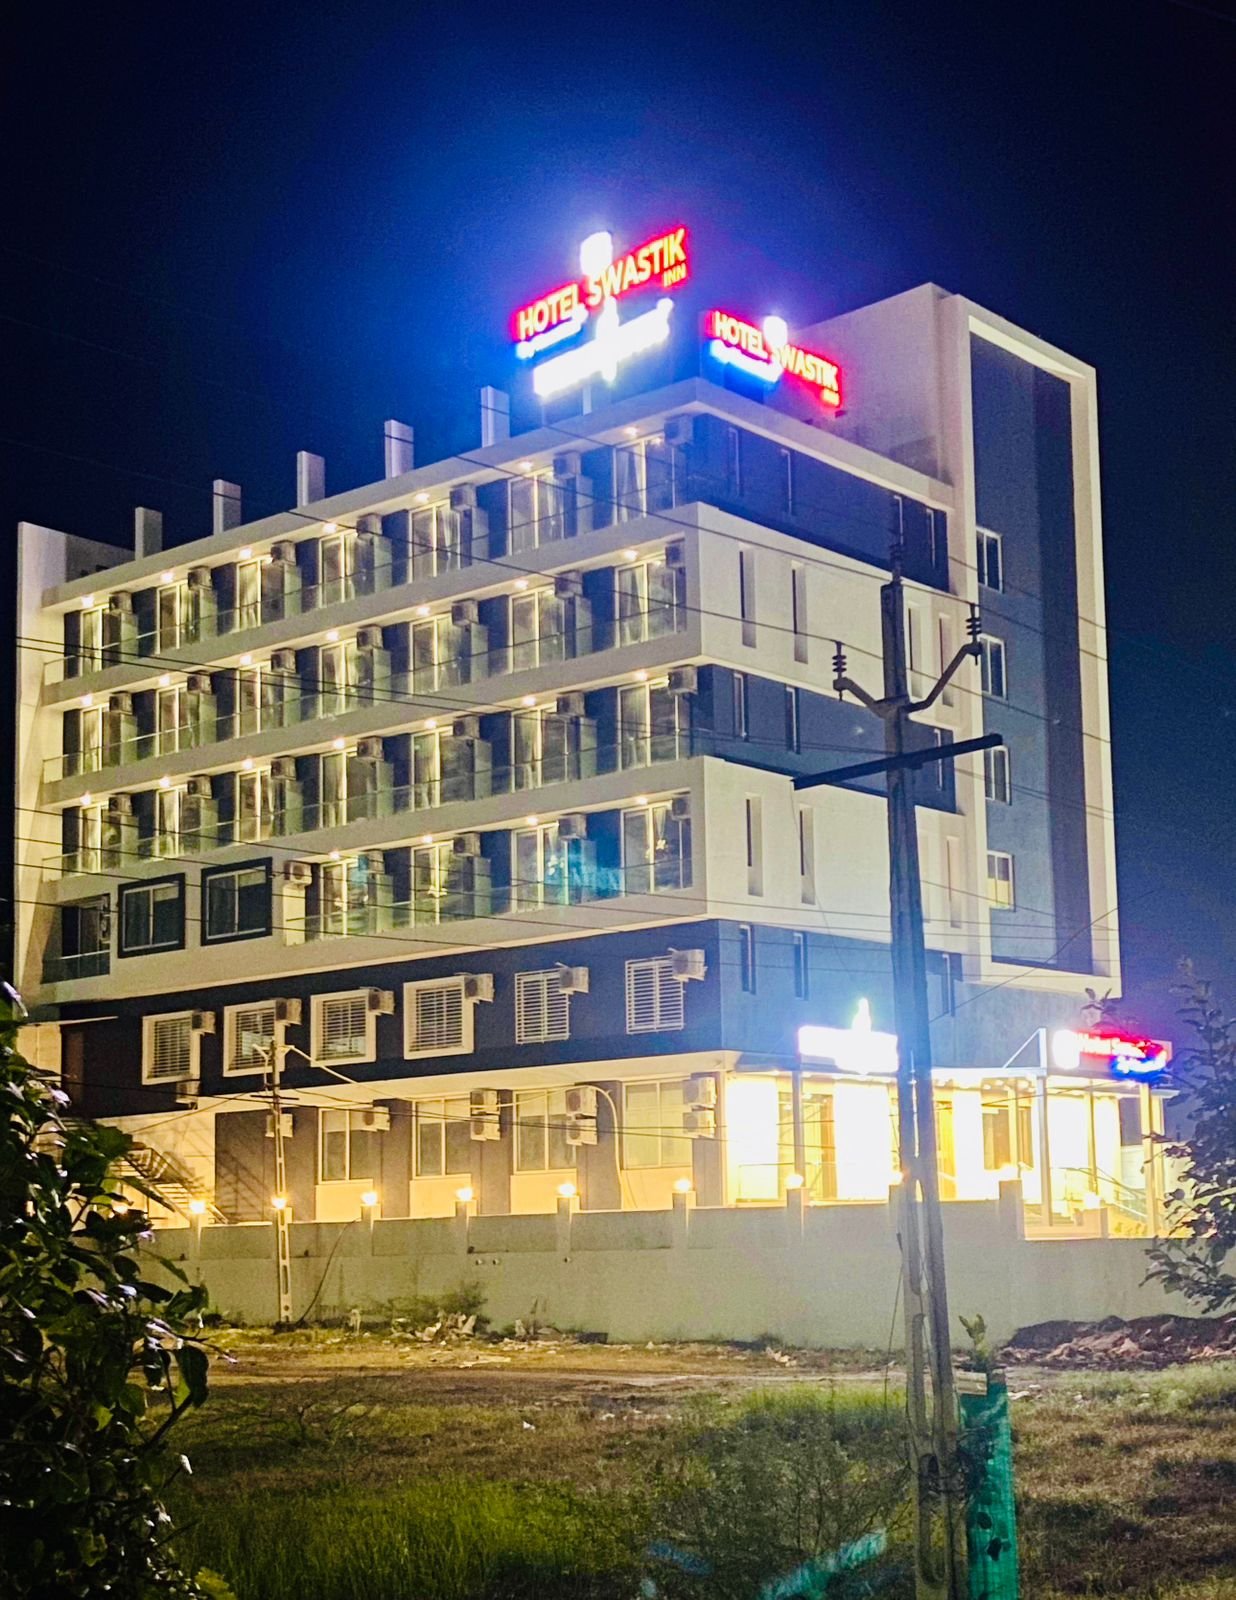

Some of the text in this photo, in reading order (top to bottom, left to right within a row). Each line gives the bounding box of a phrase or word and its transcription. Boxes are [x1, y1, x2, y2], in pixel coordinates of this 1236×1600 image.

[518, 228, 686, 340] HOTEL SWASTIK
[663, 264, 686, 287] INN
[714, 310, 768, 359] HOTEL
